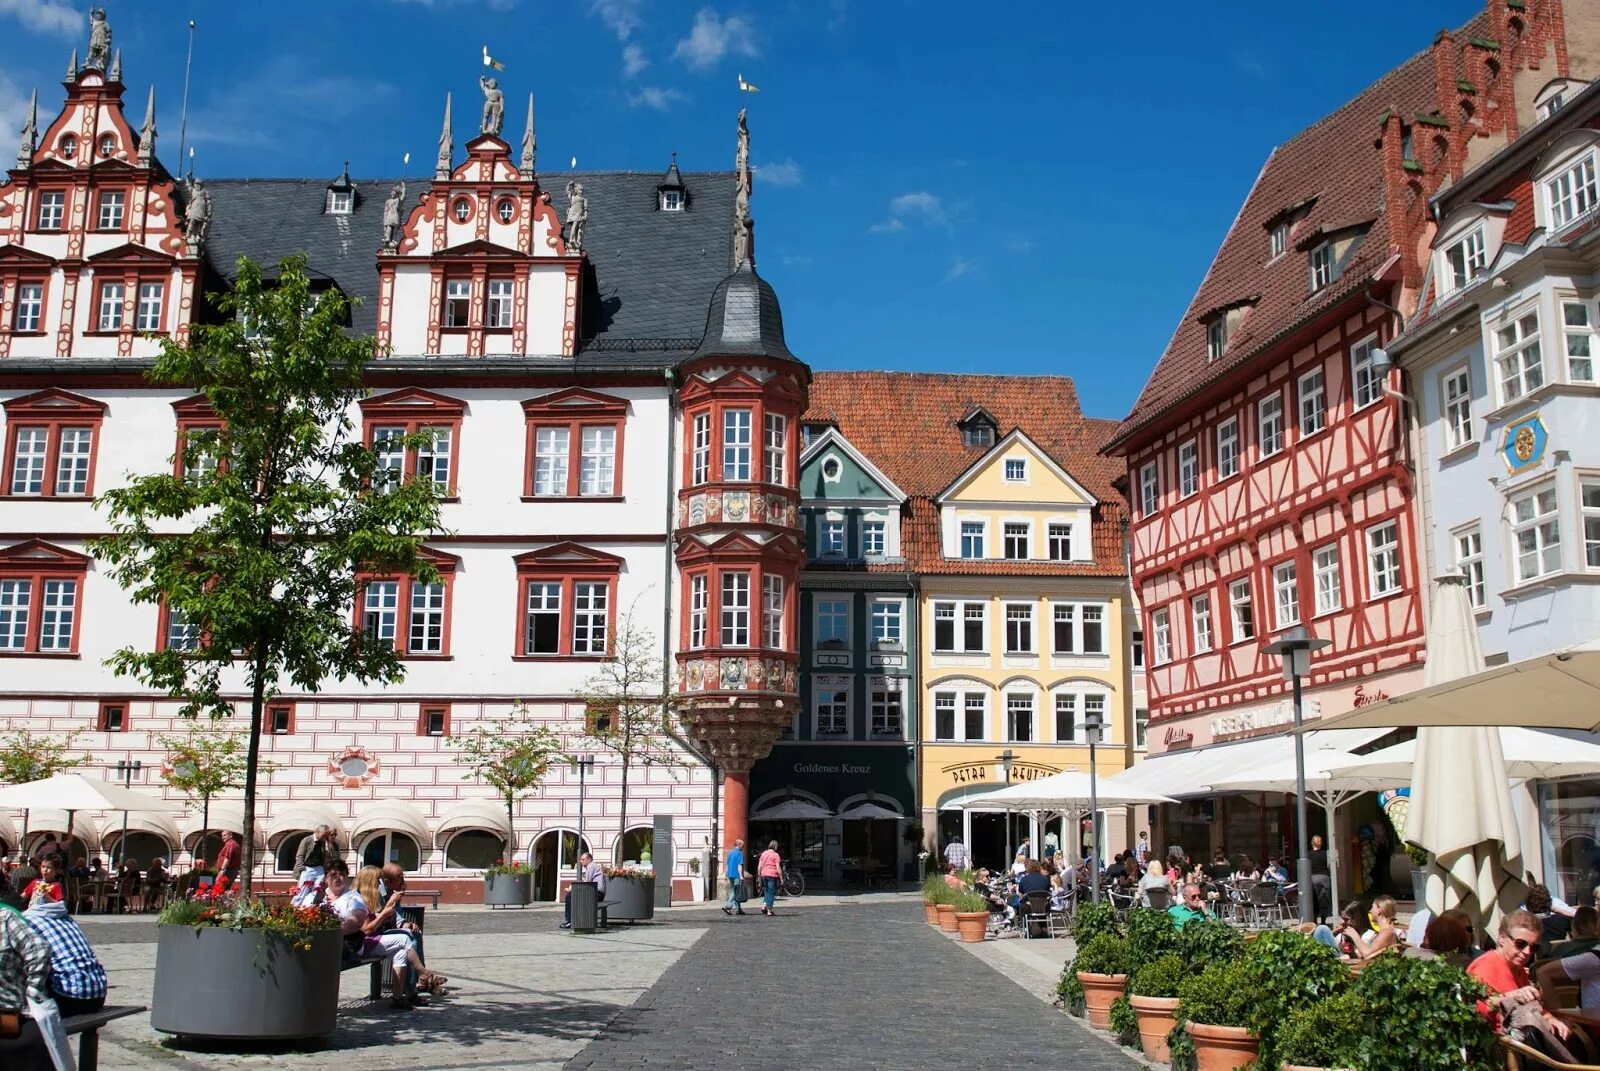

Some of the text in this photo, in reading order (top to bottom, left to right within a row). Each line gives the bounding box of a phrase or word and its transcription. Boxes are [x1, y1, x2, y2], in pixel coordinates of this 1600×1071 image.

[794, 763, 871, 773] Goldenes Kreuz
[953, 766, 1057, 783] PETRA REUT
